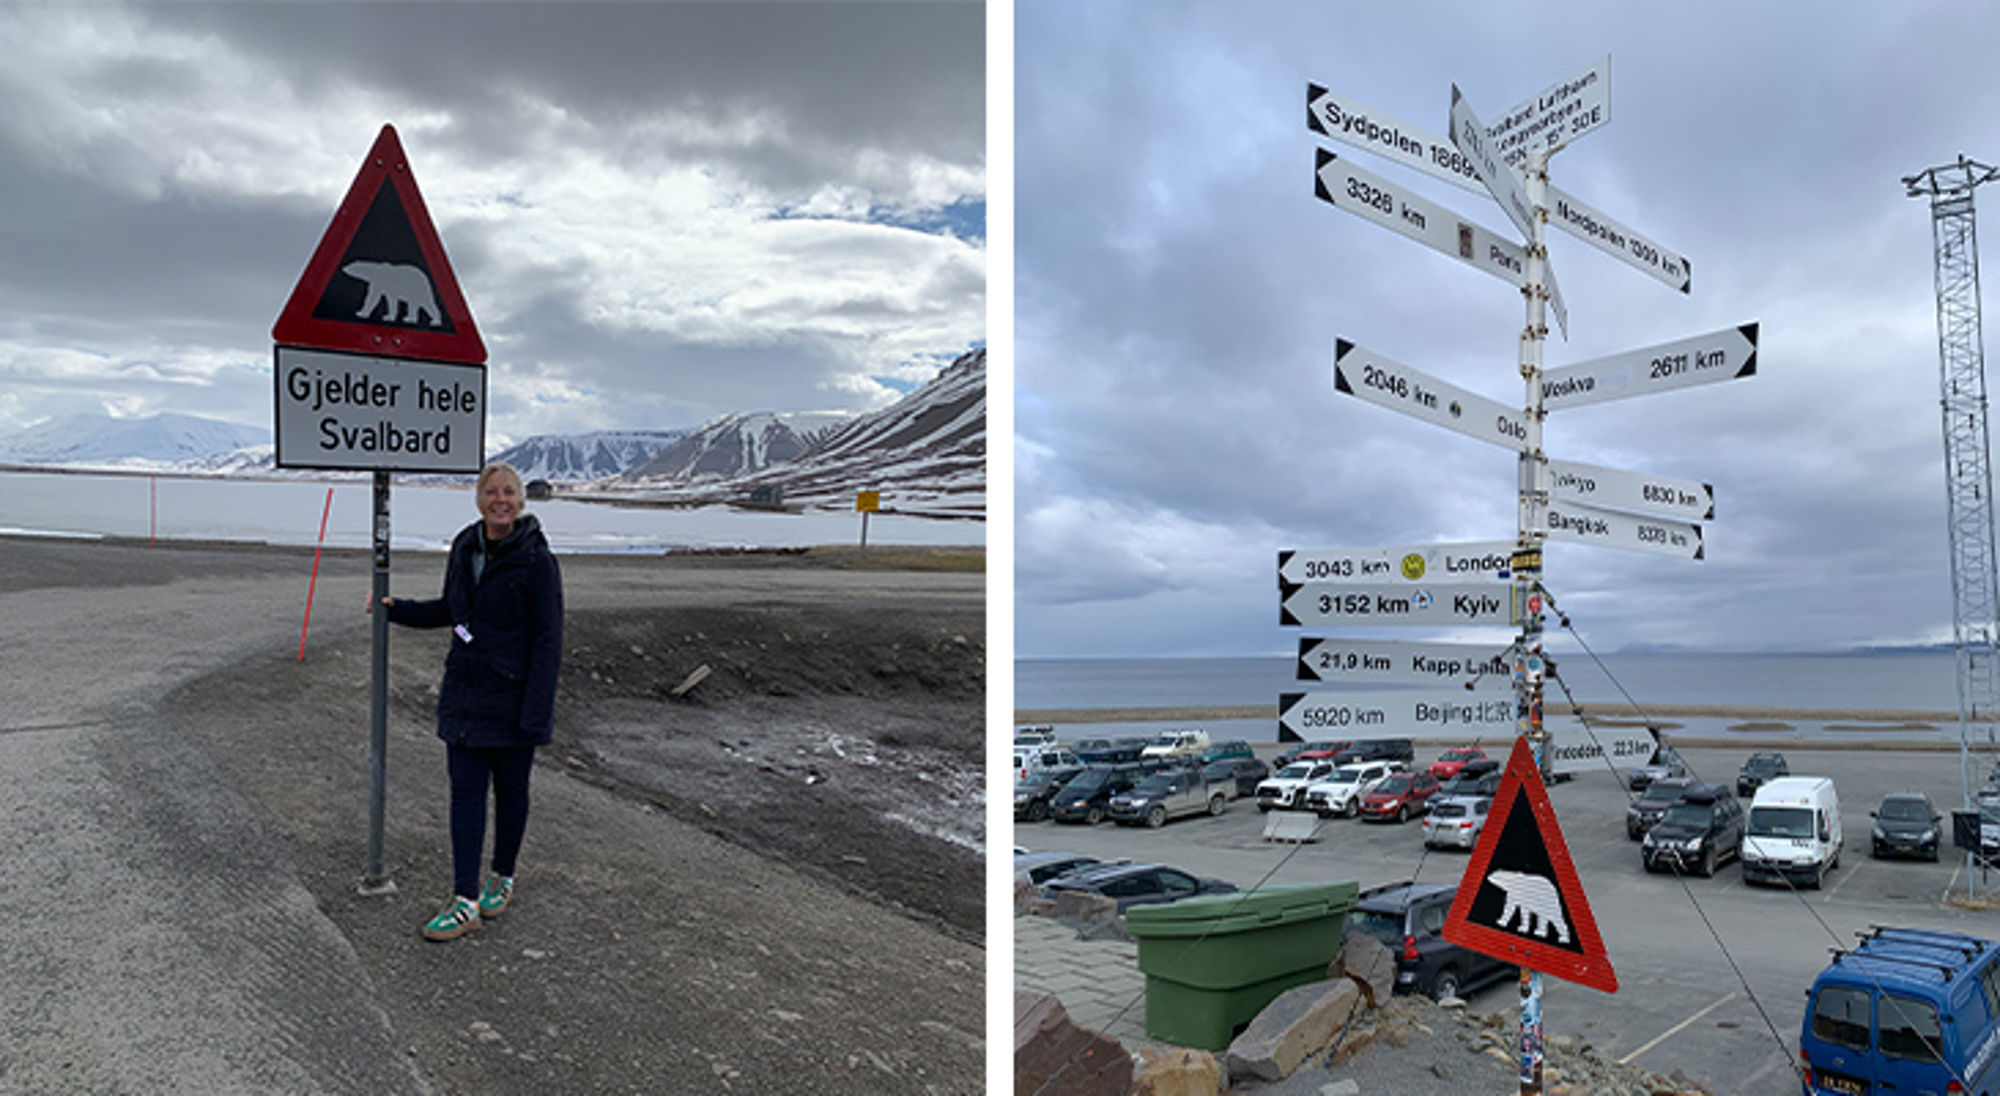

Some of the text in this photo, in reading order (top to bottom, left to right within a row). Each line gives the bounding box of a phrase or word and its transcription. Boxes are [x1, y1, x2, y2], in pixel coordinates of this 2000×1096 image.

[1325, 102, 1422, 157] Sydpolen
[1402, 202, 1425, 230] km
[1490, 245, 1521, 274] Paris
[1557, 200, 1626, 249] Nordpolen
[1662, 255, 1681, 277] km
[1650, 353, 1688, 379] 2611
[1695, 349, 1725, 370] km
[287, 367, 476, 413] Gjelder hele
[1363, 365, 1527, 440] 2046 km Oslo
[319, 417, 450, 454] Svalbard
[1679, 490, 1699, 507] km
[1548, 512, 1609, 535] Bangkok
[1306, 559, 1354, 578] 3043
[1361, 559, 1390, 576] km
[1319, 594, 1501, 618] 3152 km Kyiv
[1319, 652, 1358, 671] 21,9
[1363, 653, 1391, 671] km
[1413, 656, 1461, 677] Kapp
[1303, 707, 1351, 727] 5920
[1355, 706, 1385, 725] km
